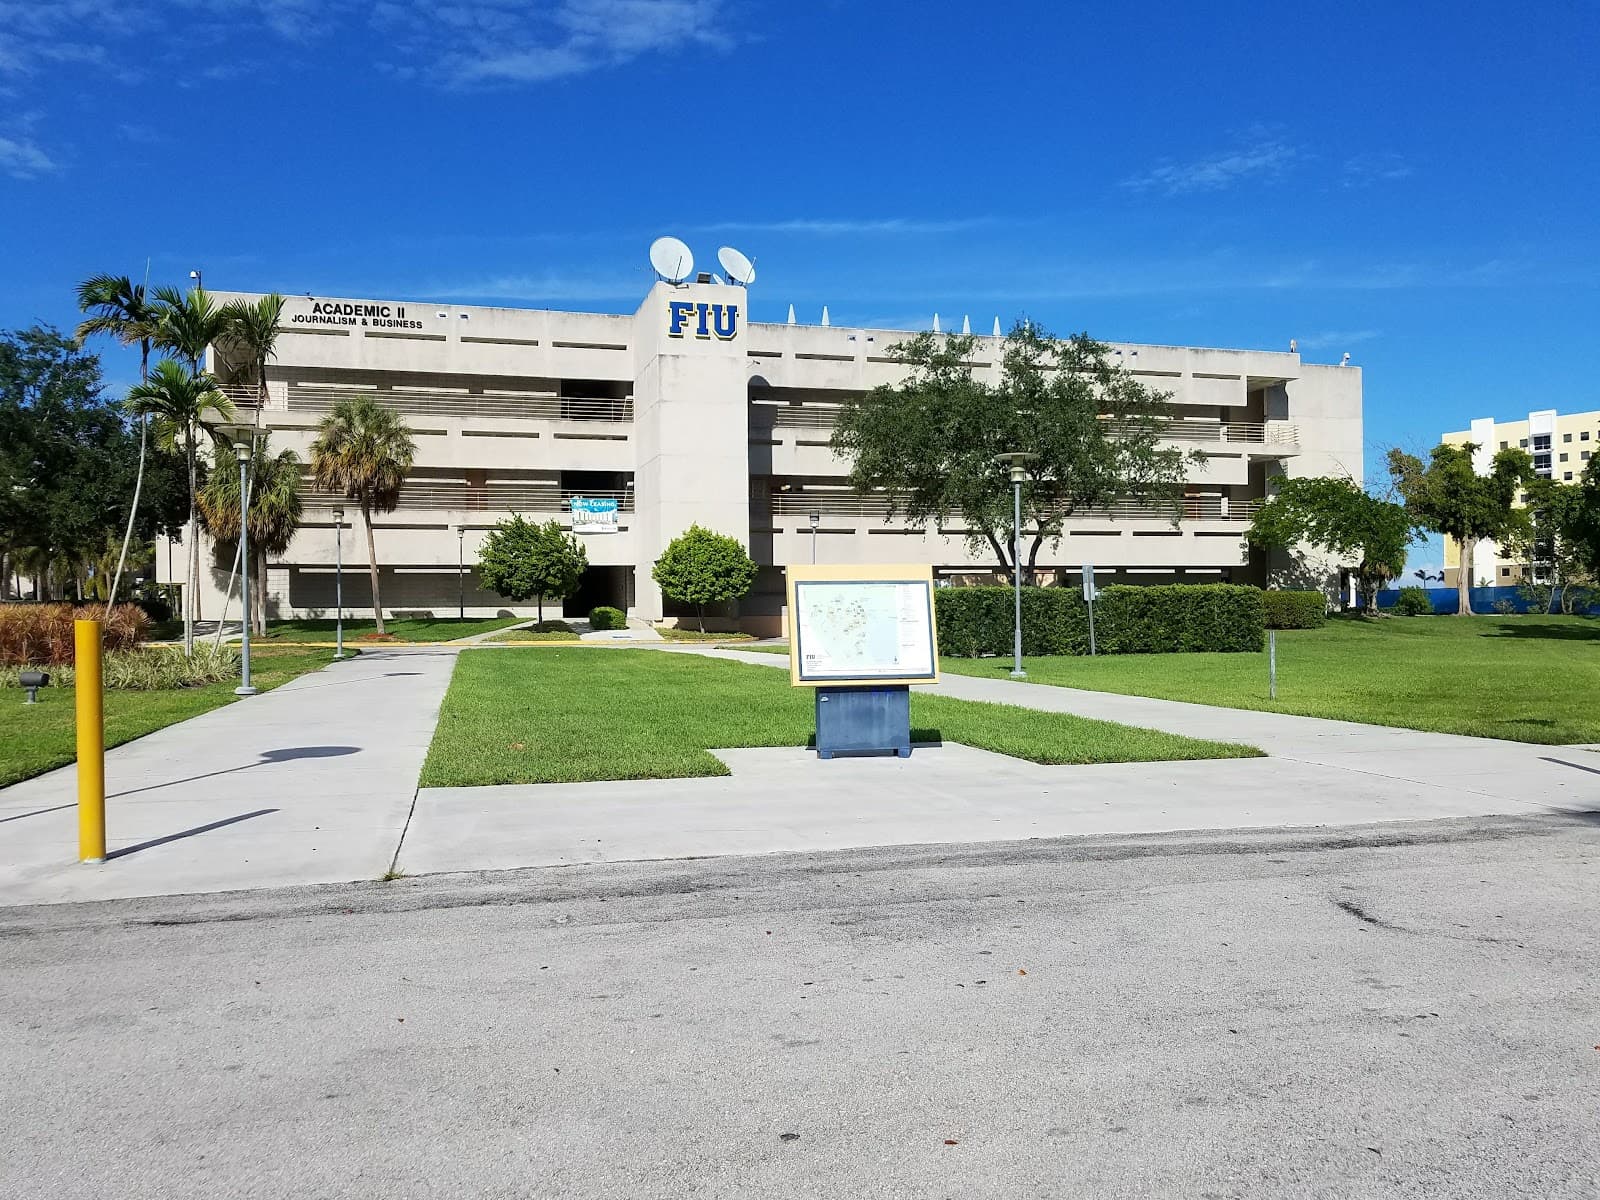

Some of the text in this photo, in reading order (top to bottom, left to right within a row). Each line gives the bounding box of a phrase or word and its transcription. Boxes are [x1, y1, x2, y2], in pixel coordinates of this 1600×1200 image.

[313, 302, 405, 319] ACADEMIC II
[291, 314, 423, 329] JOURNALISM & BUSINESS
[668, 300, 739, 341] FIU
